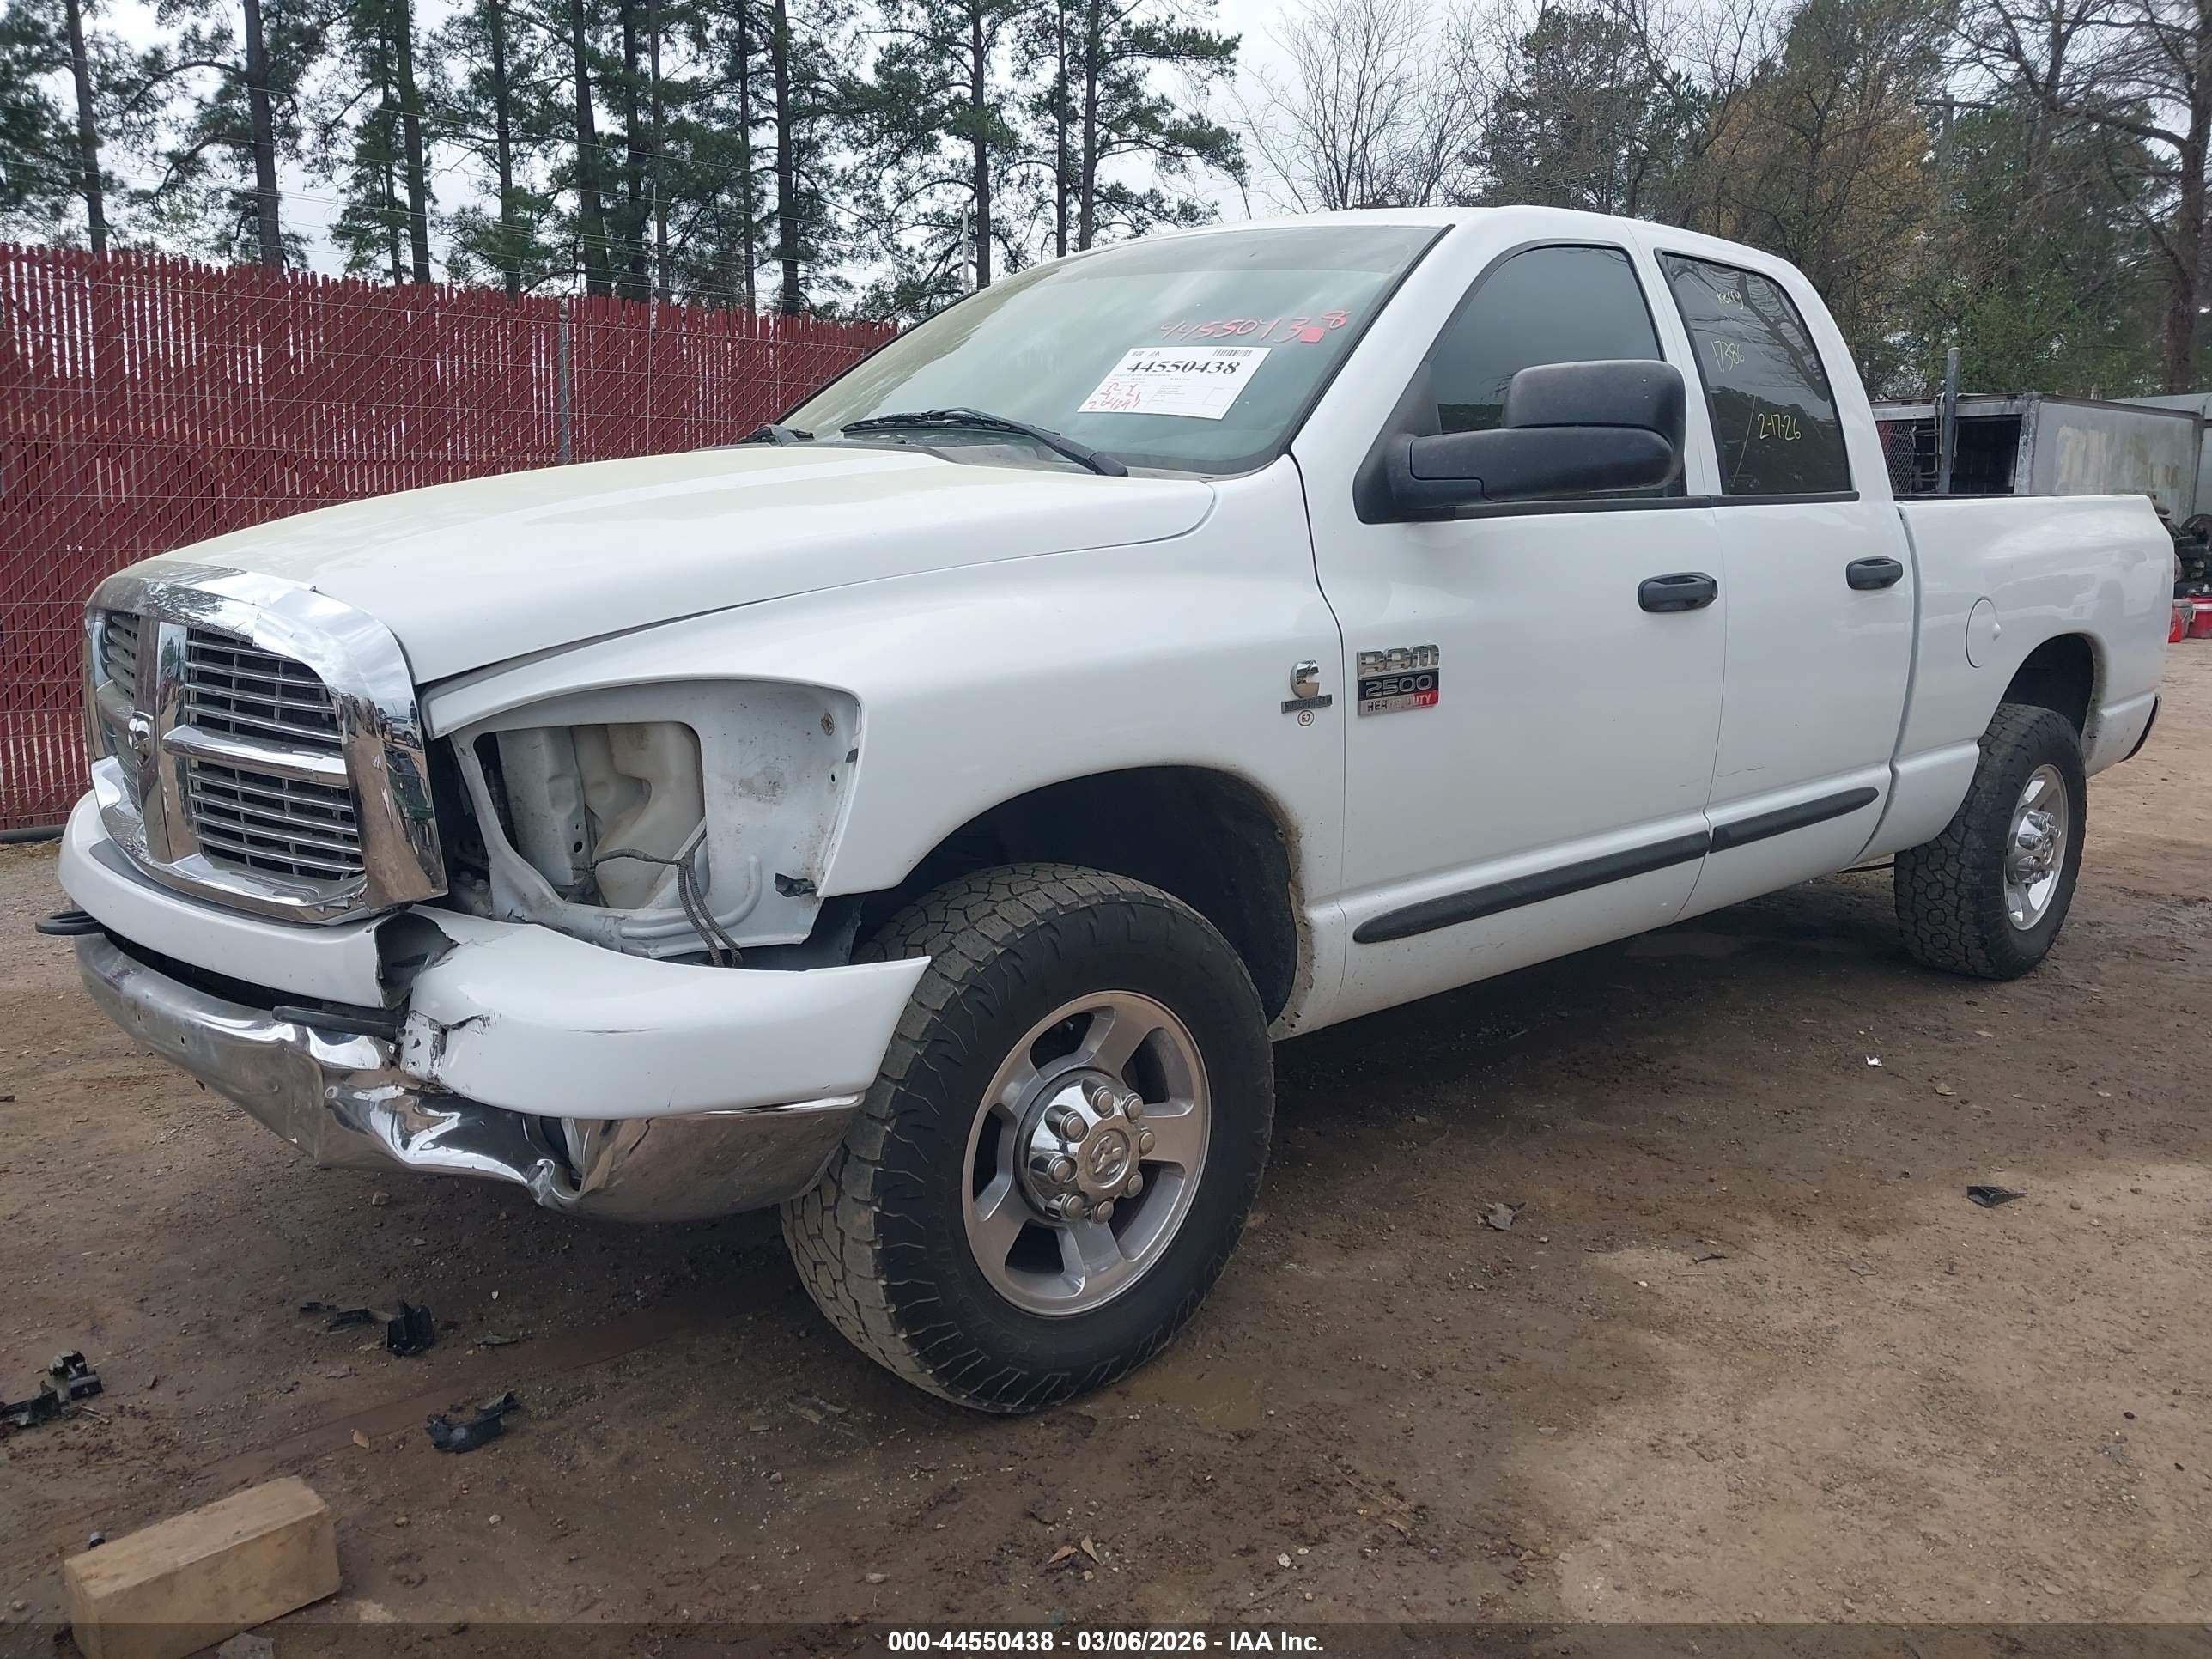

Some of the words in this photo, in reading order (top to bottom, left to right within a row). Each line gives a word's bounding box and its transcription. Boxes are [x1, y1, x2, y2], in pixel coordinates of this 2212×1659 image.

[1127, 360, 1241, 375] 44550438
[1757, 413, 1802, 440] 2-17-26
[1365, 674, 1433, 697] 2500
